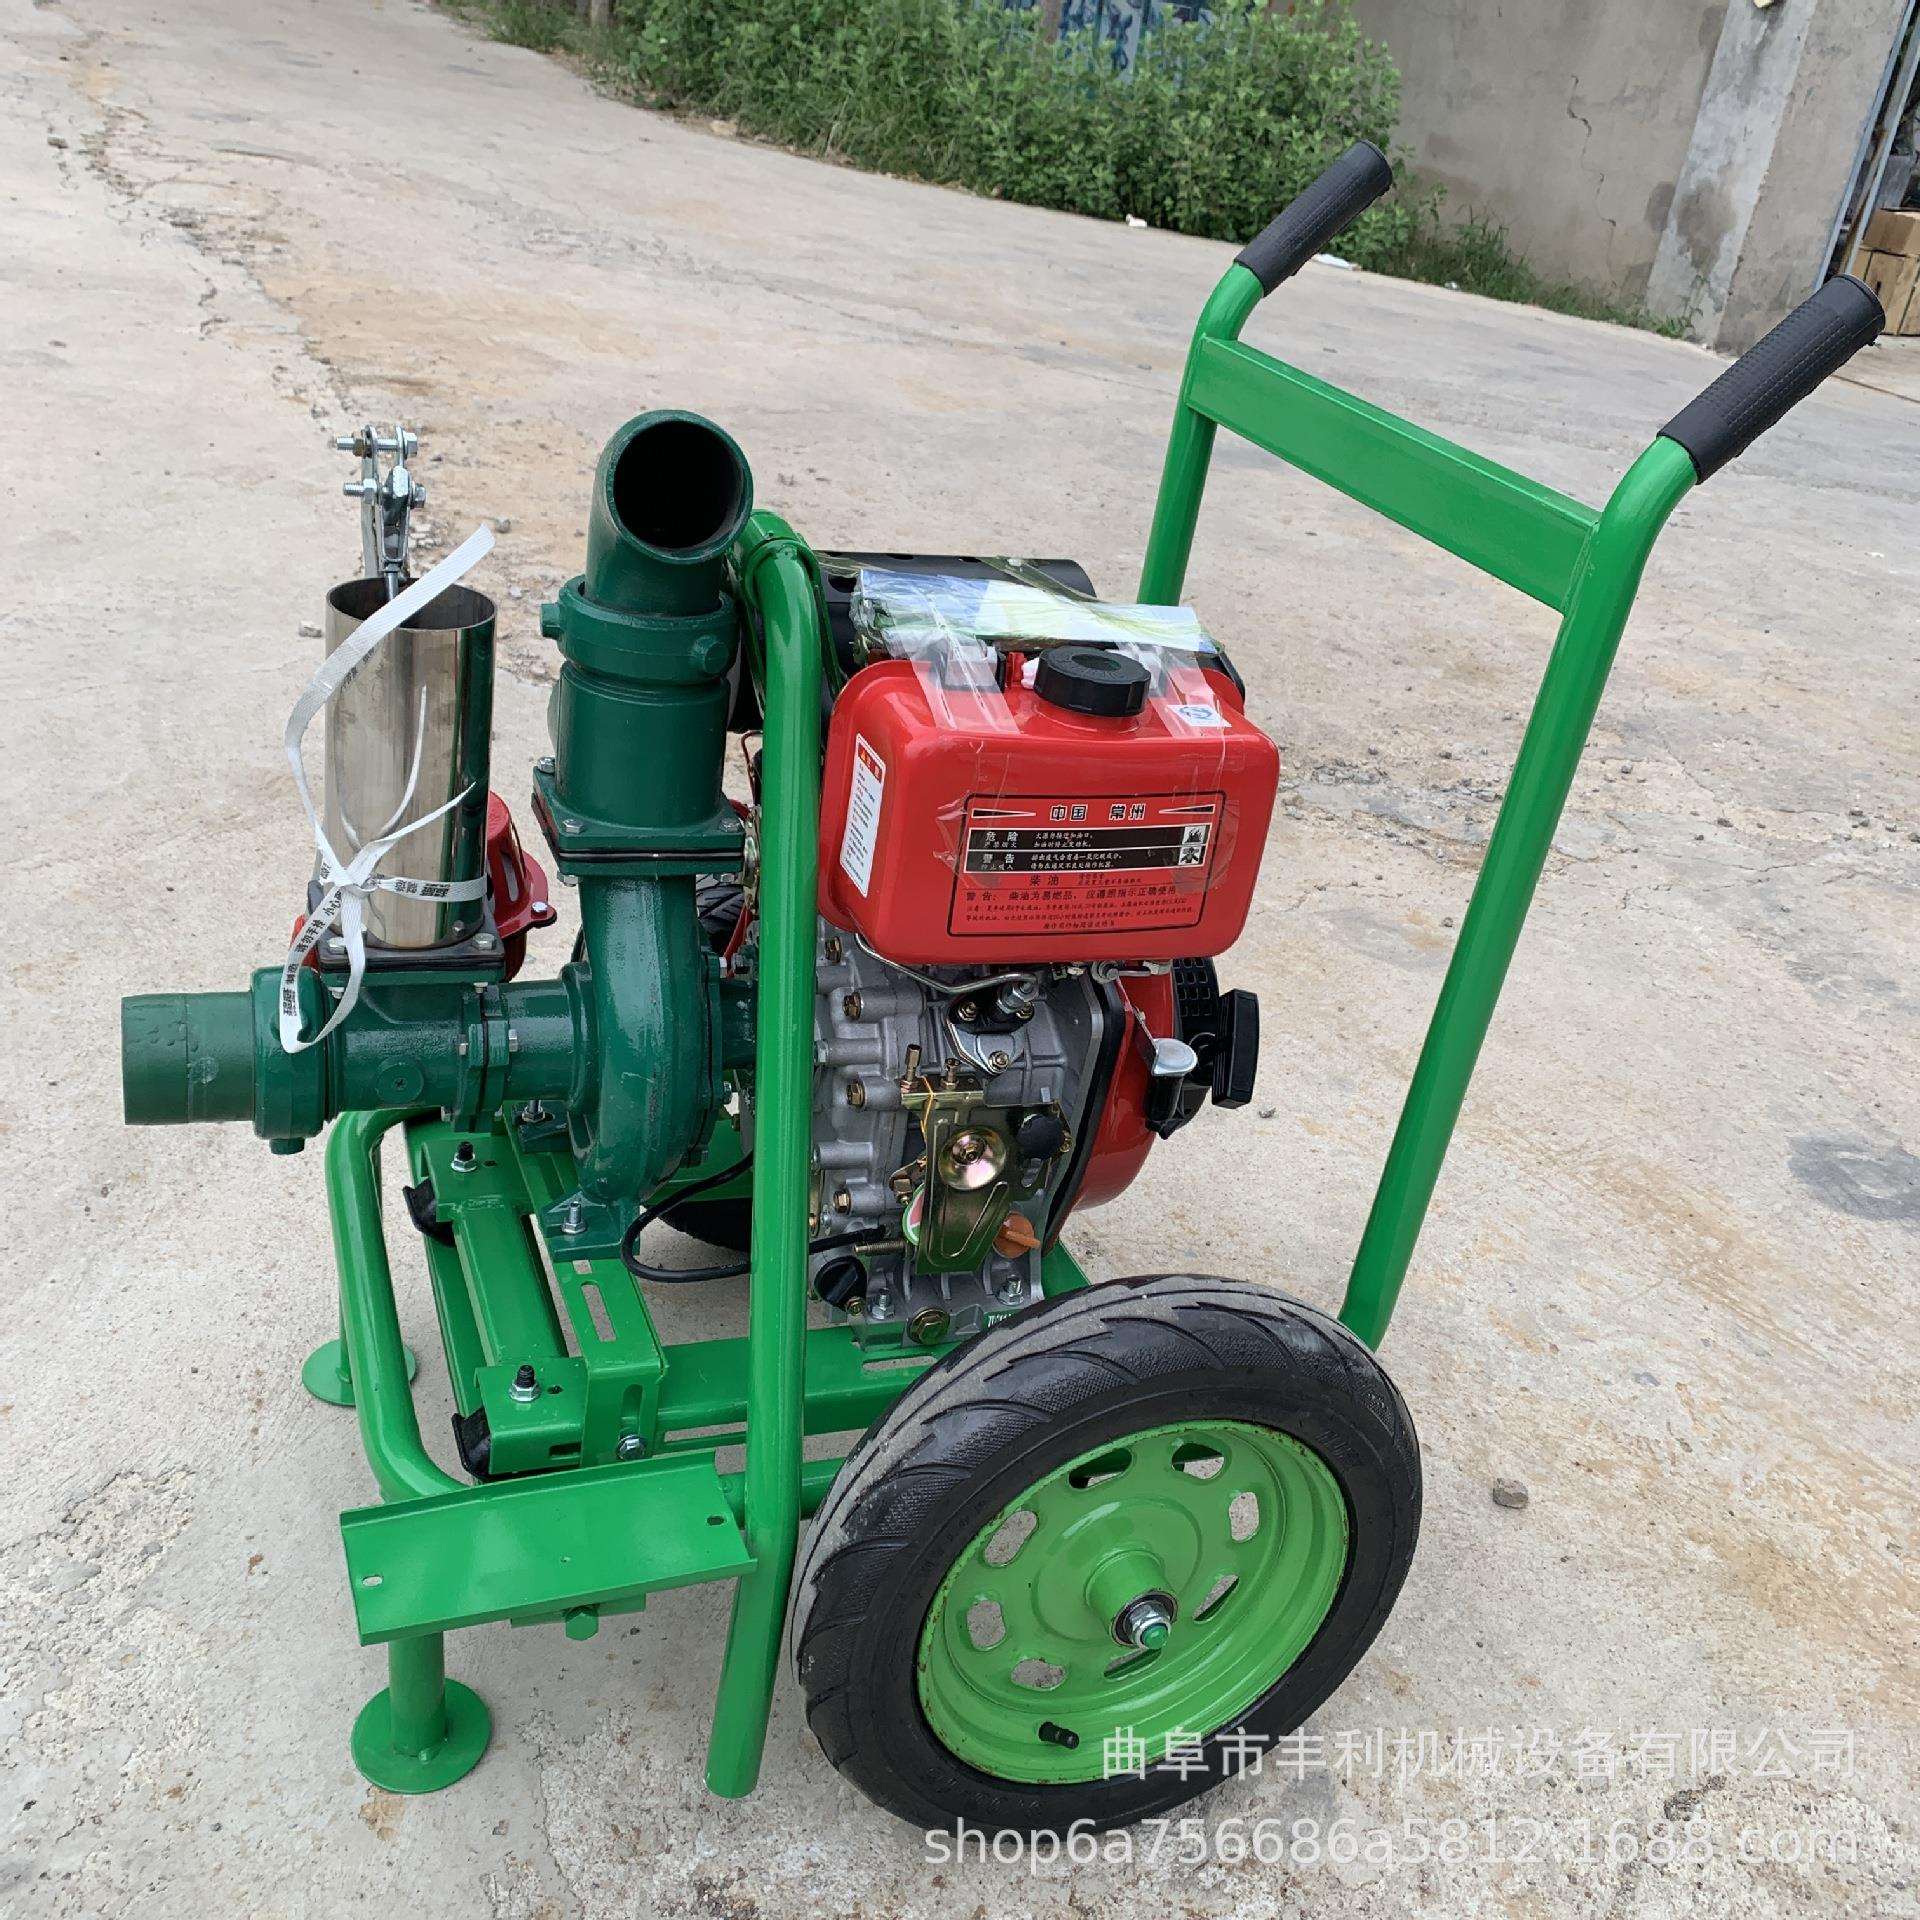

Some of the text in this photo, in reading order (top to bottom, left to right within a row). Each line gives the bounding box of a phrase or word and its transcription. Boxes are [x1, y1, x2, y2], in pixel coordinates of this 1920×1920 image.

[985, 803, 1147, 842] 中国 常州 危险
